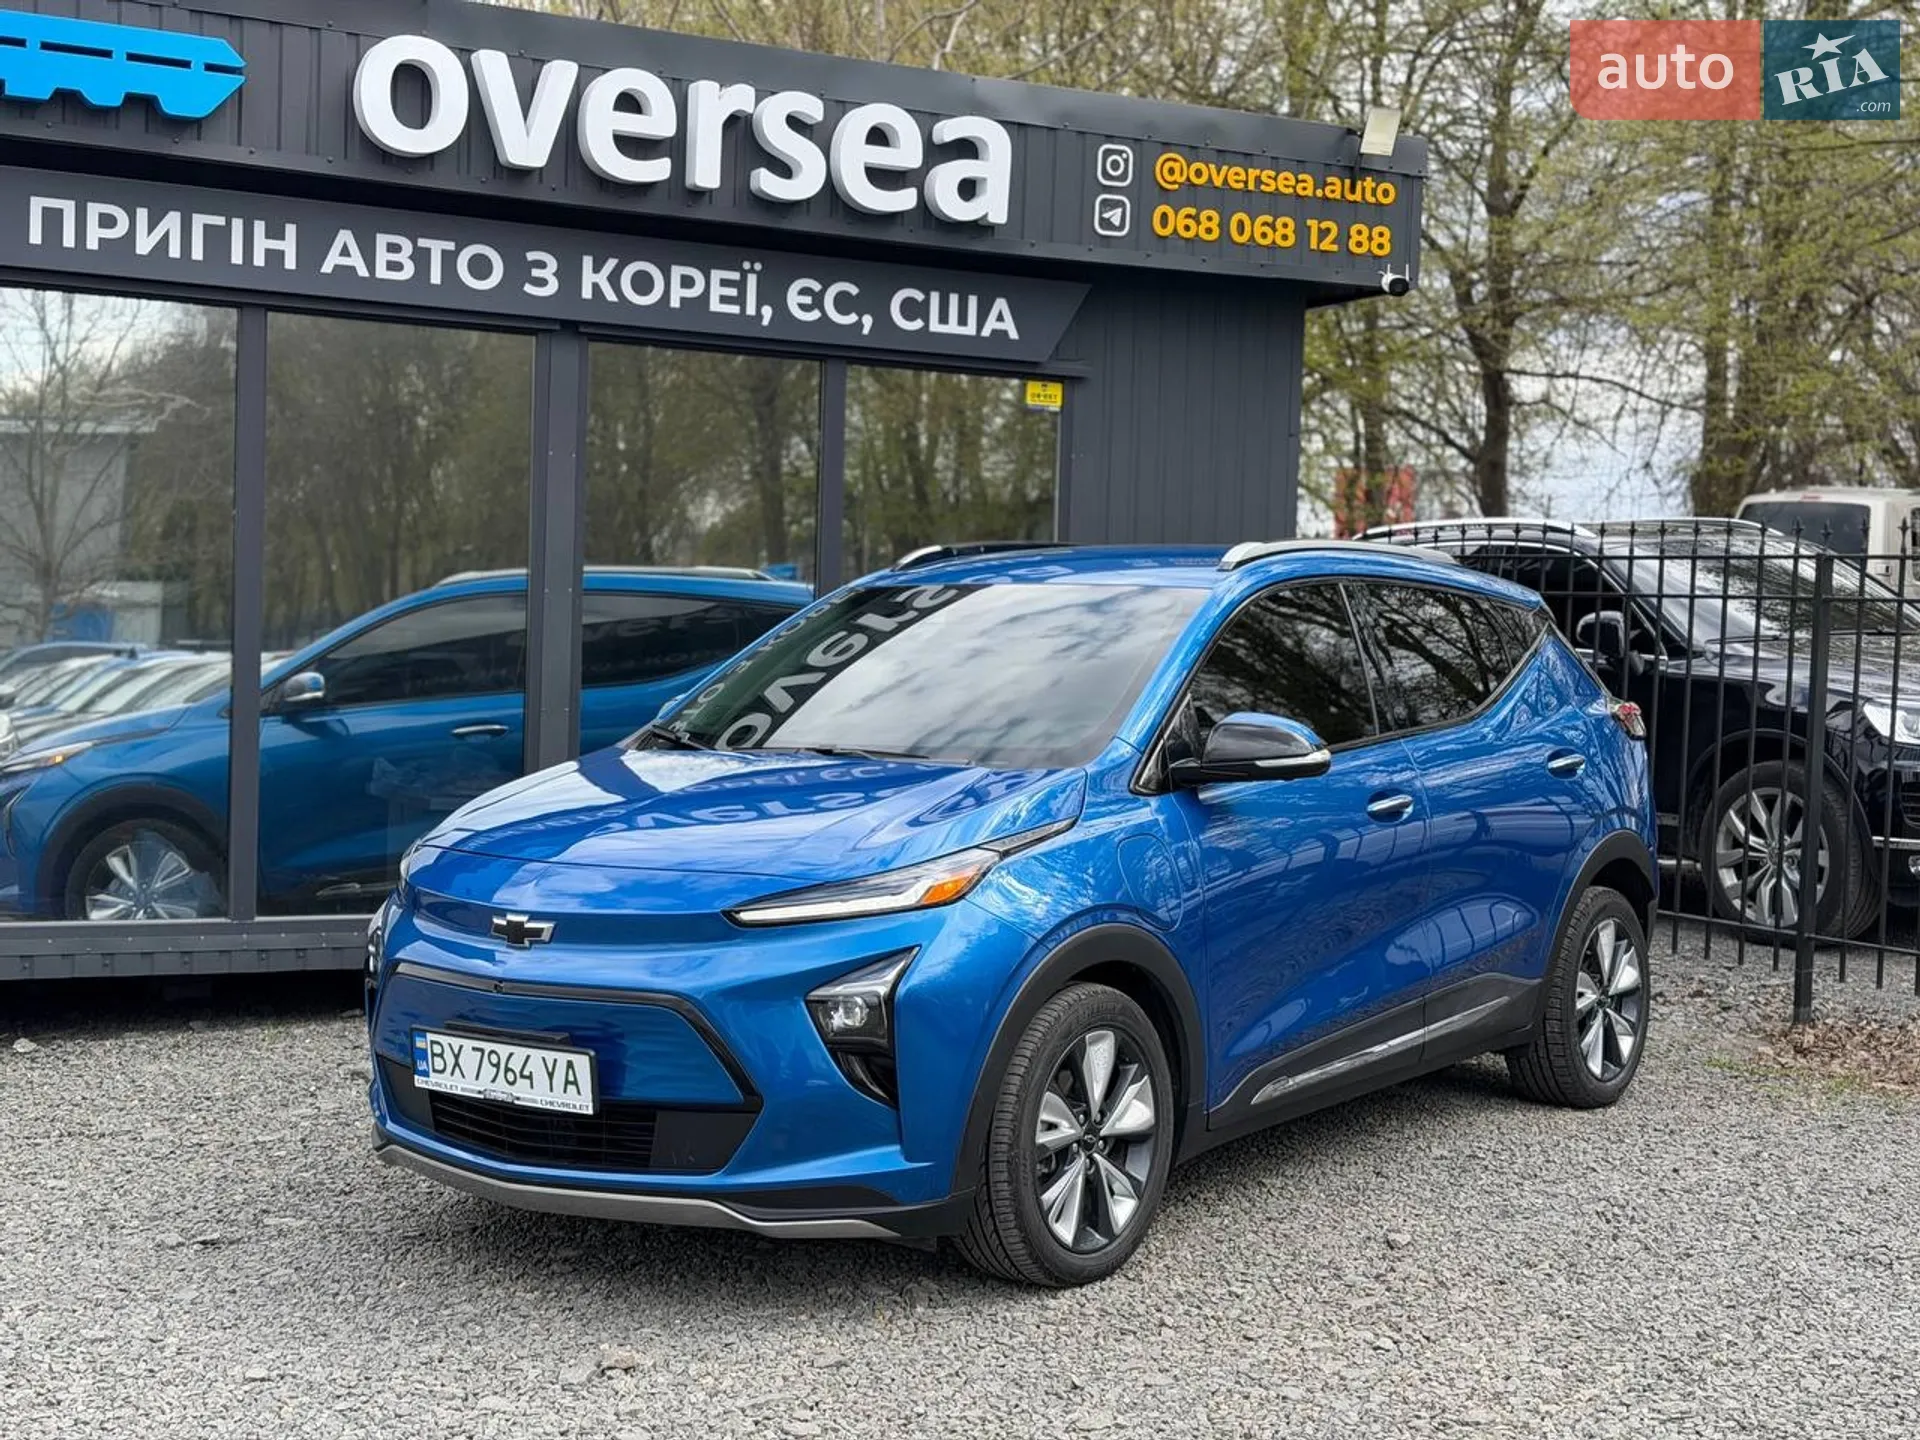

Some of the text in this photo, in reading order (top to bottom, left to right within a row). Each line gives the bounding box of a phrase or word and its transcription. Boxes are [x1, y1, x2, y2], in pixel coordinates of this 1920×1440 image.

[353, 34, 1012, 226] oversea
[1154, 152, 1397, 205] @oversea.auto
[1152, 204, 1391, 257] 068 068 12 88
[28, 195, 1019, 341] ПРИГІН АВТО З КОРЕЇ, ЄС, США
[416, 1060, 429, 1072] UA
[471, 1046, 534, 1090] 7964
